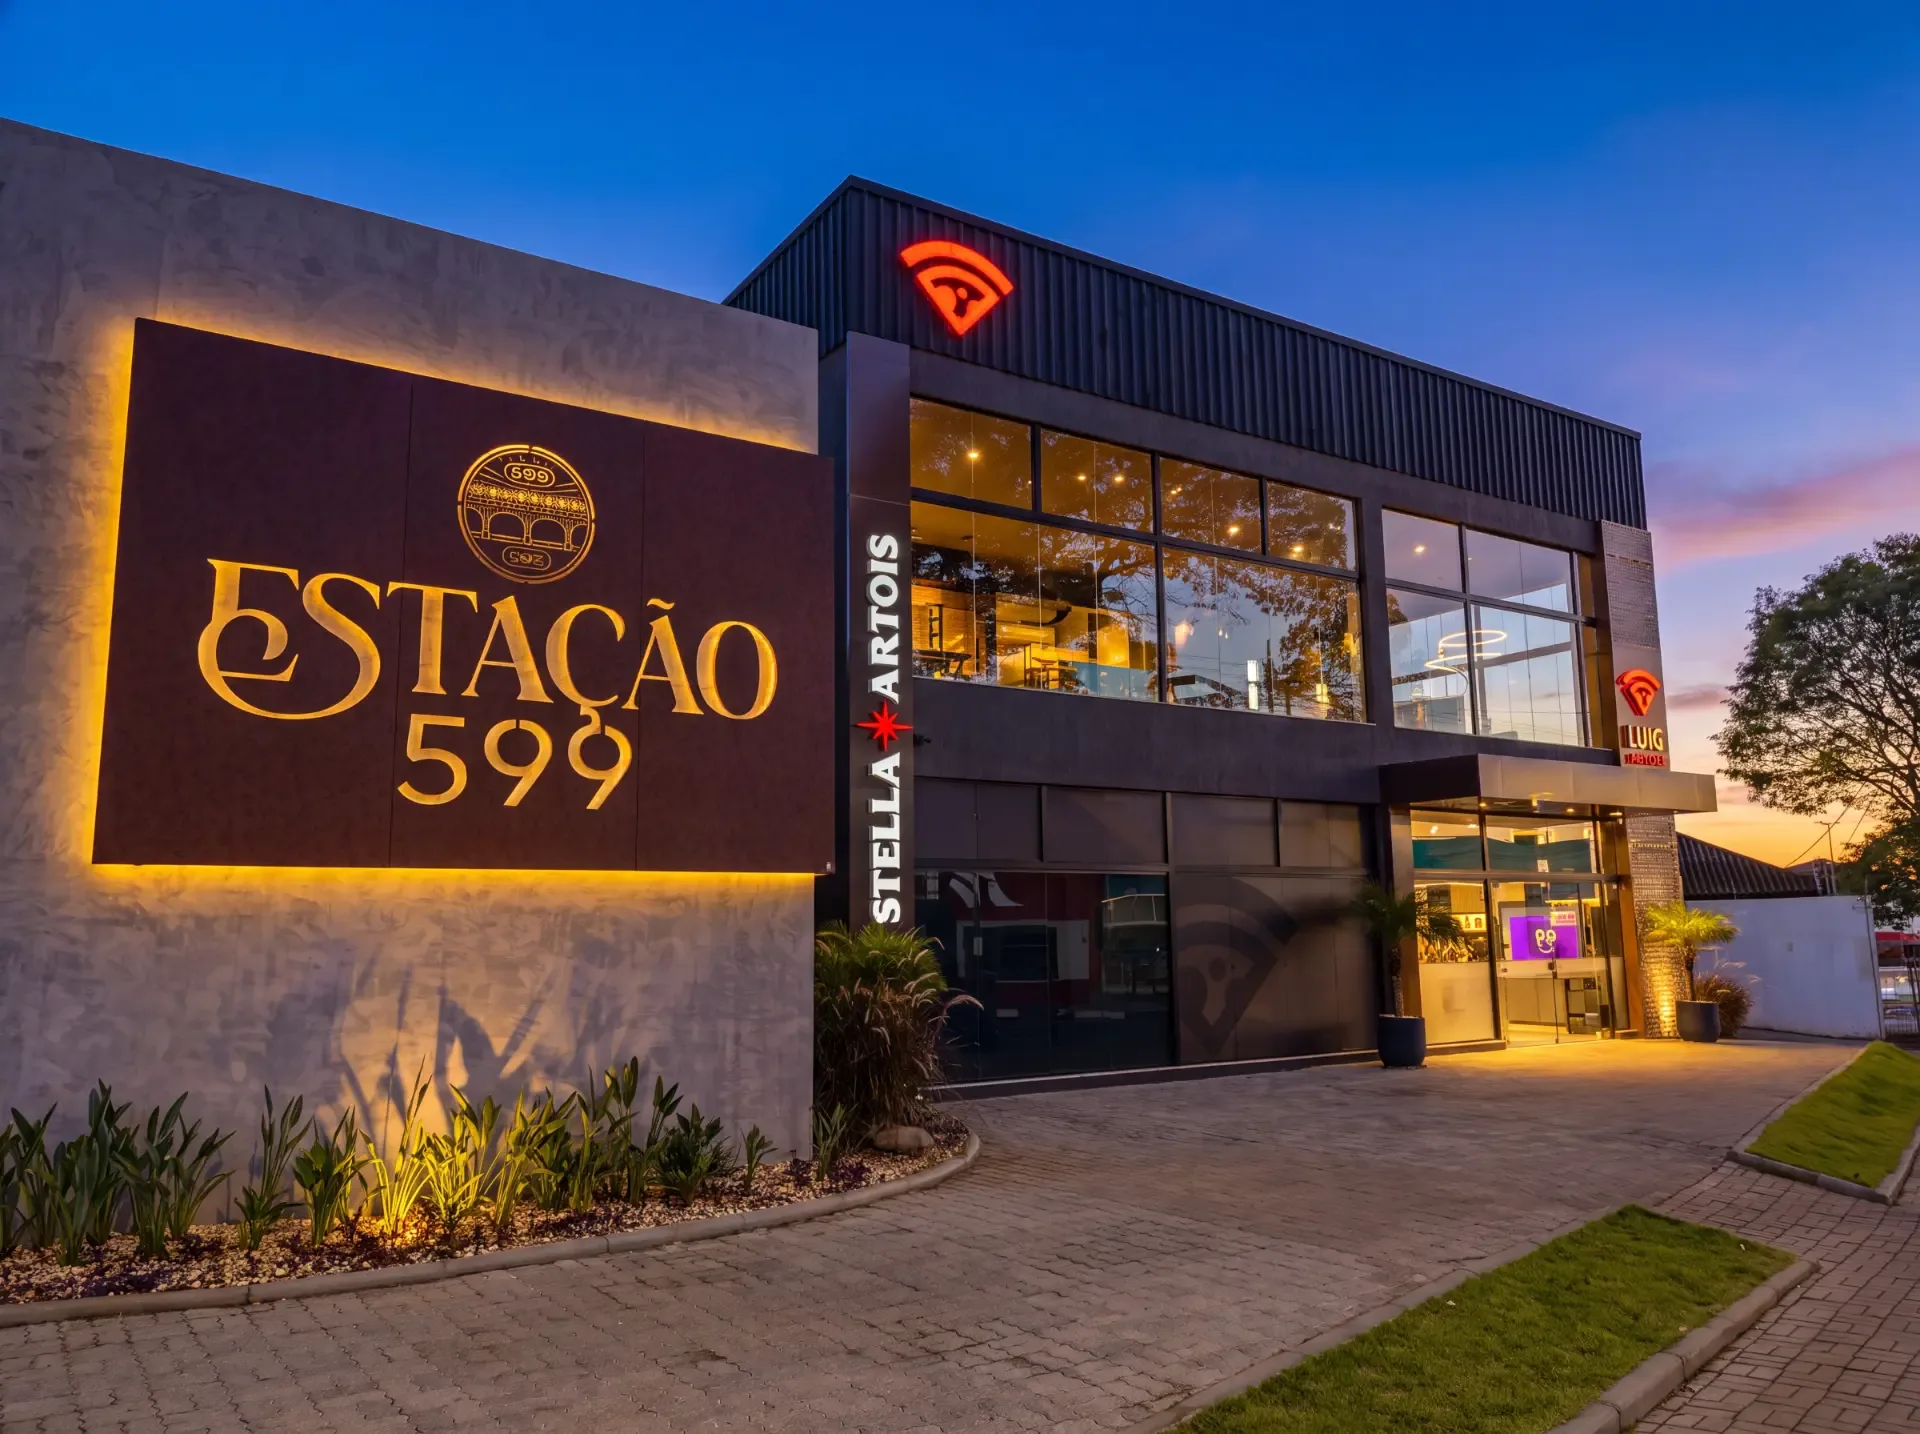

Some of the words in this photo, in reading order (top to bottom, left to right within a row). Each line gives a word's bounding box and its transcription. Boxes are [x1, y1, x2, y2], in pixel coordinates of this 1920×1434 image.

[197, 558, 778, 722] ESTAÇÃO
[866, 533, 901, 705] ARTOIS
[397, 712, 633, 810] 599
[867, 751, 902, 924] STELLA
